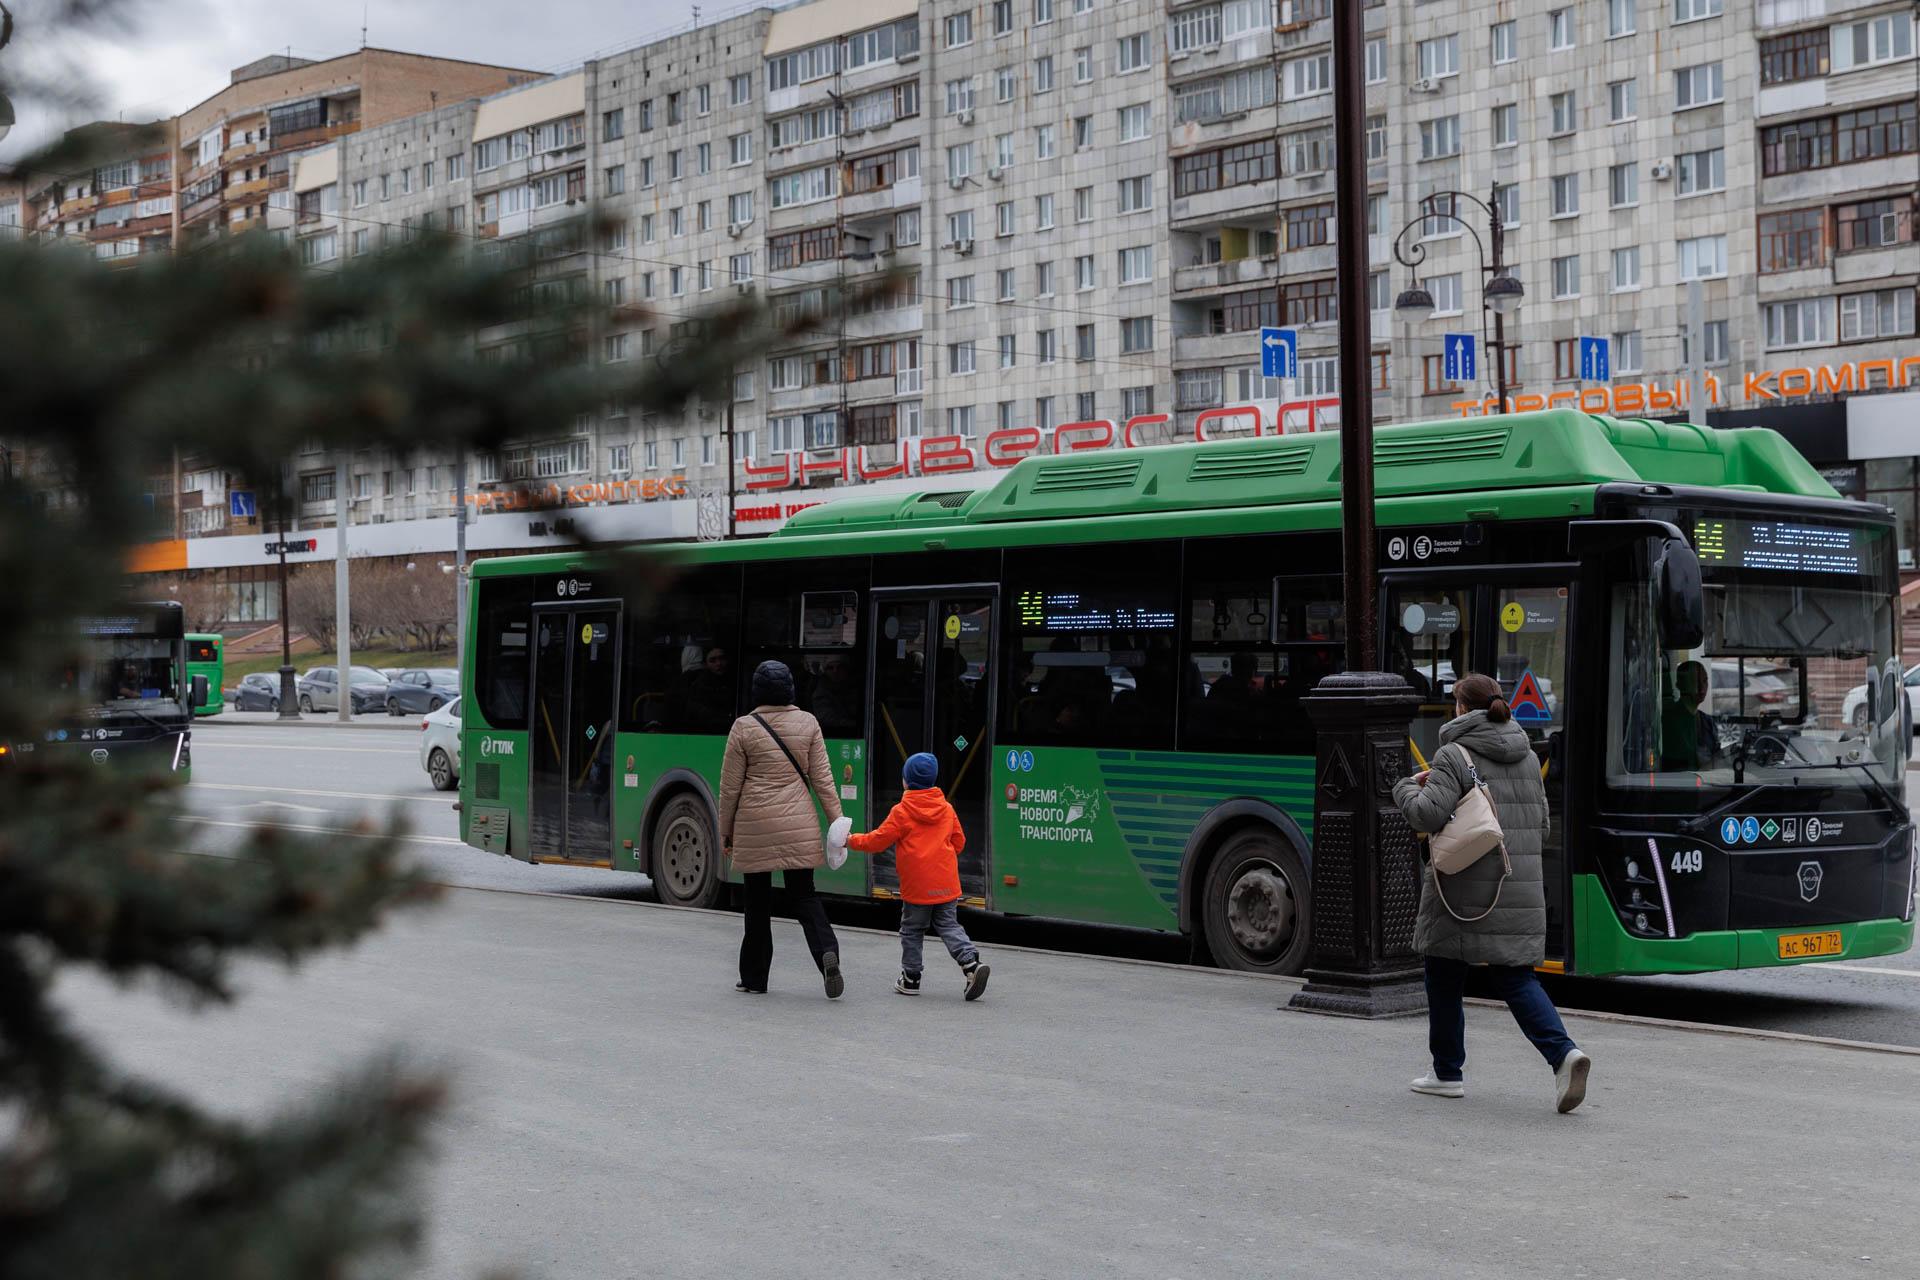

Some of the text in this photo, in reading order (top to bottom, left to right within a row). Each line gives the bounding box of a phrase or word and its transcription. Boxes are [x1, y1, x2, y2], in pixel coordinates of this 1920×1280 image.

[492, 740, 514, 755] ГТЛК
[1020, 788, 1057, 803] ВРЕМЯ
[1020, 806, 1064, 822] НОВОГО
[1020, 825, 1094, 843] ТРАНСПОРТА
[1671, 850, 1703, 874] 449
[1785, 934, 1838, 955] АС 967 72
